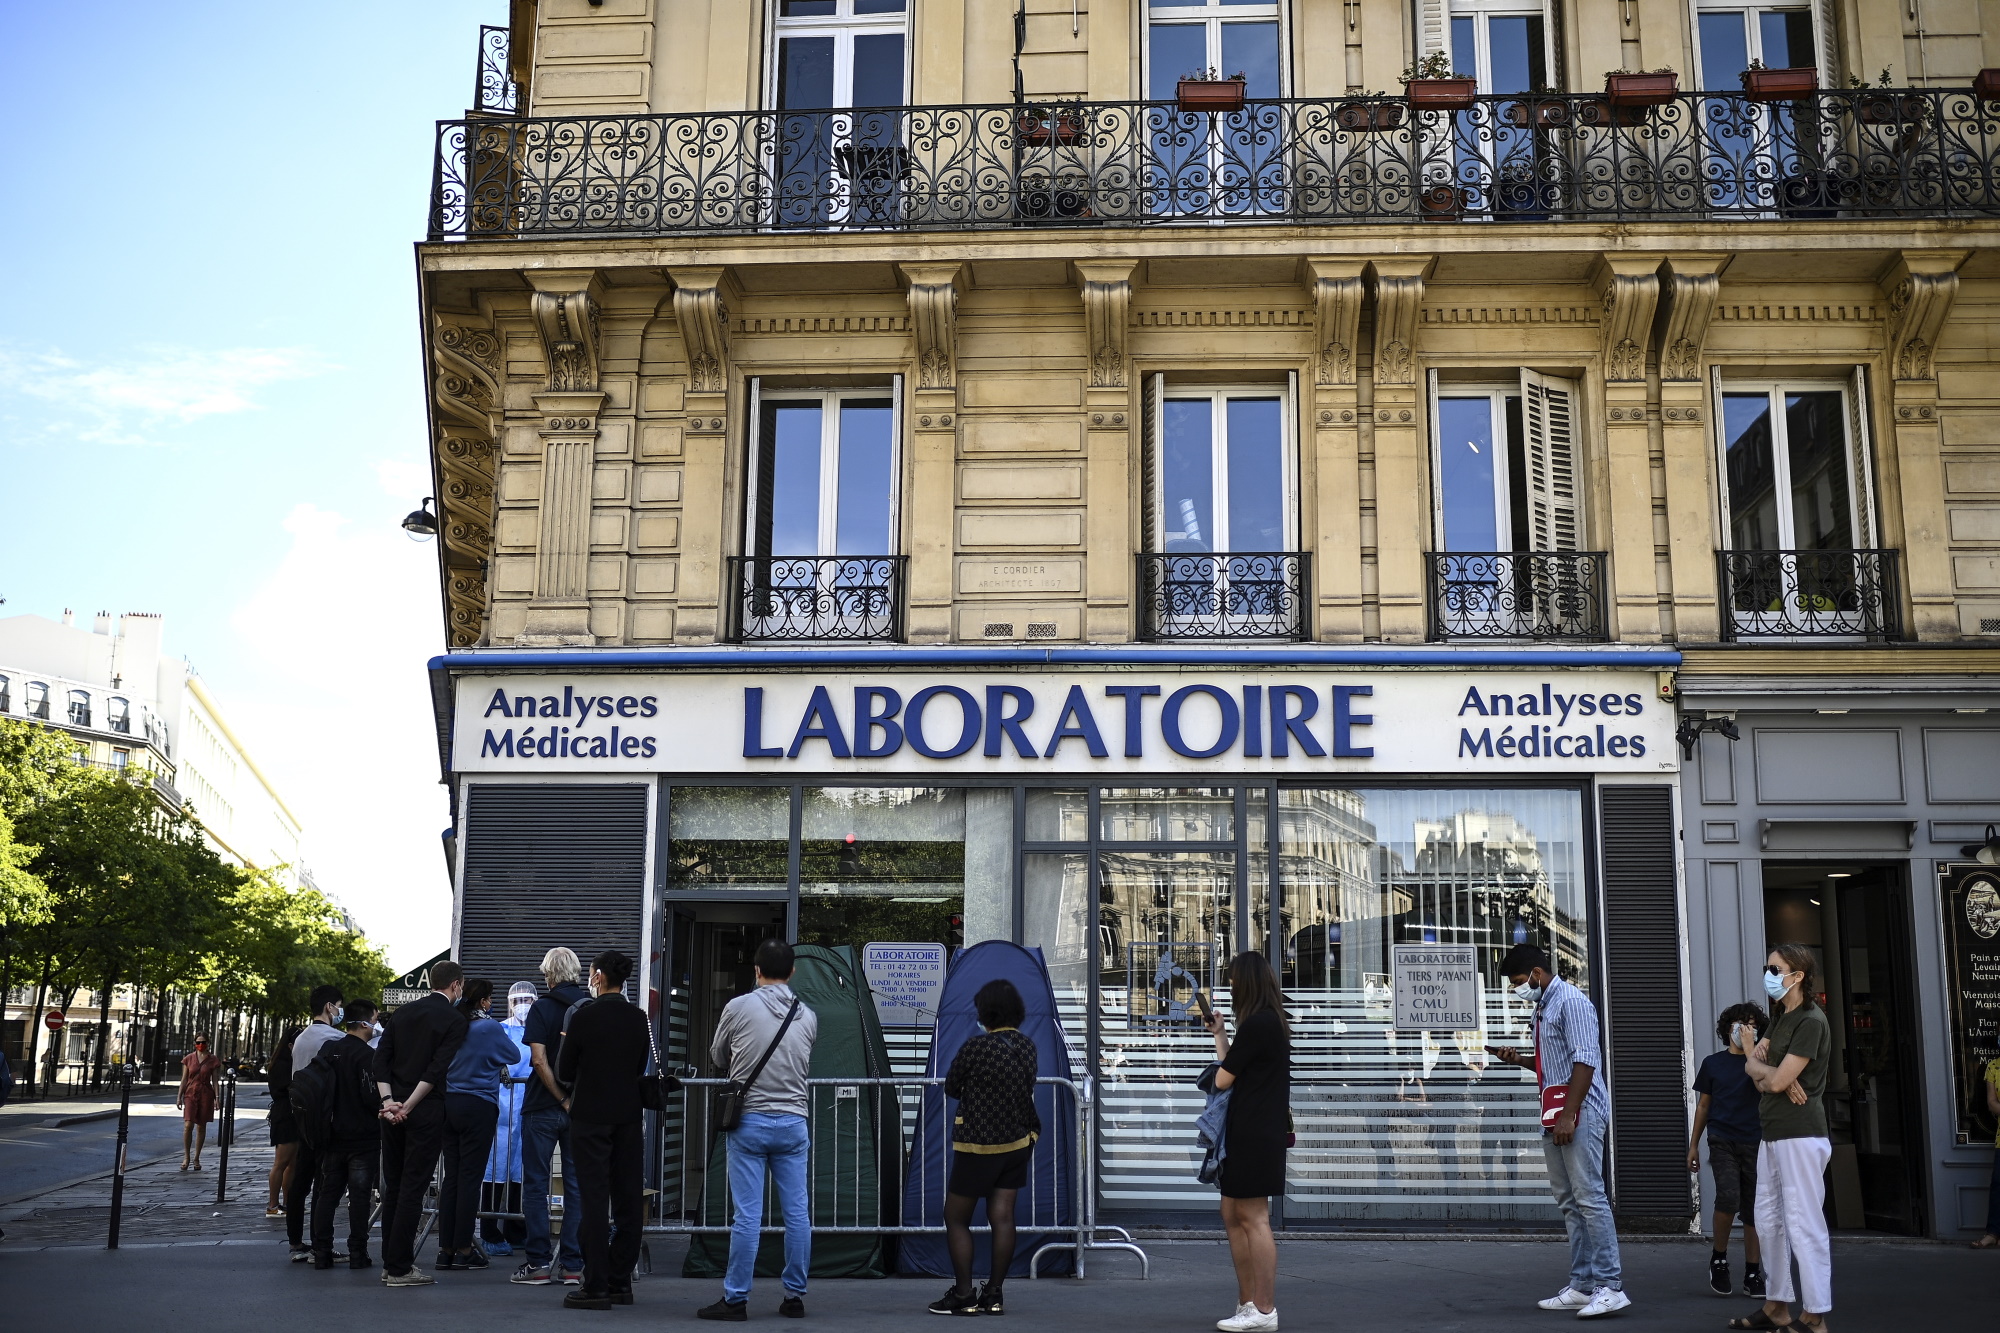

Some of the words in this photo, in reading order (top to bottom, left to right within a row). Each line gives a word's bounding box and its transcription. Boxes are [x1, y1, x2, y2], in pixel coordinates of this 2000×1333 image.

[1003, 566, 1045, 574] CORDIER
[978, 579, 1033, 588] ARCHITECTE
[484, 685, 658, 728] Analyses
[1458, 683, 1644, 727] Analyses
[742, 684, 1375, 758] LABORATOIRE
[481, 726, 657, 758] Médicales
[1458, 725, 1646, 758] Médicales
[869, 951, 940, 960] LABORATOIRE
[1398, 954, 1472, 964] LABORATOIRE
[1970, 953, 1991, 962] Pain
[1407, 971, 1432, 981] TIERS
[1437, 971, 1473, 981] PAYANT
[1412, 984, 1447, 996] 100%
[402, 993, 427, 1002] HAPP
[1412, 998, 1448, 1009] CMU
[1409, 1012, 1473, 1023] MUTUELLES
[1978, 1018, 1998, 1027] Flan
